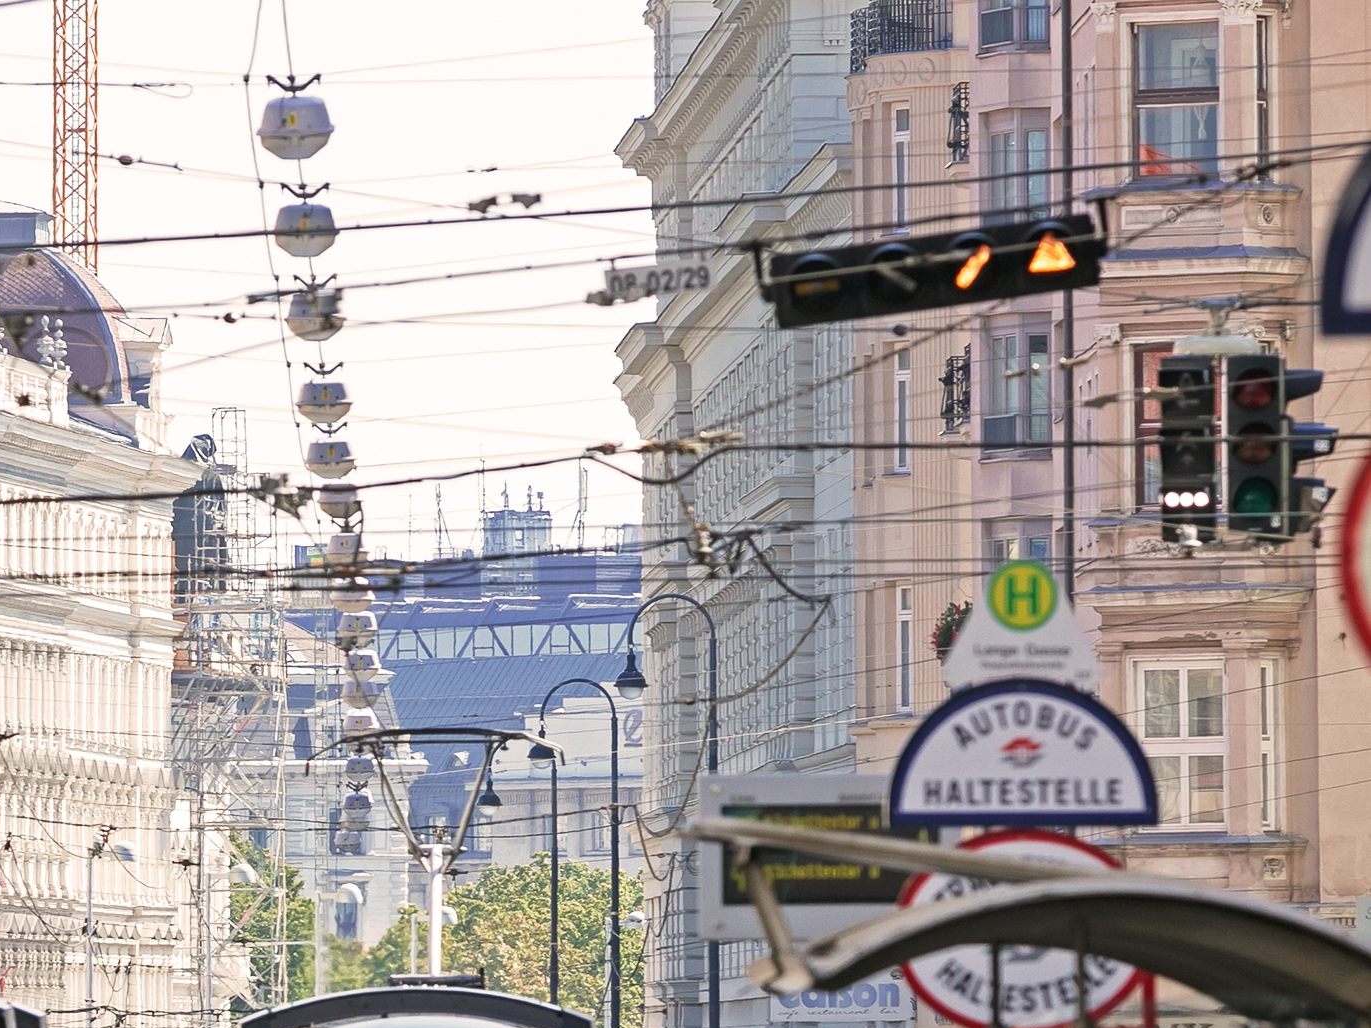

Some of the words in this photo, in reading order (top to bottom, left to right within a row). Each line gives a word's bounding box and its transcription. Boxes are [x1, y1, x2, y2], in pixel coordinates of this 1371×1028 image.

[952, 700, 1098, 750] AUTOBUS
[924, 778, 1122, 806] HALTESTELLE
[935, 956, 1118, 1012] HALESTELE
